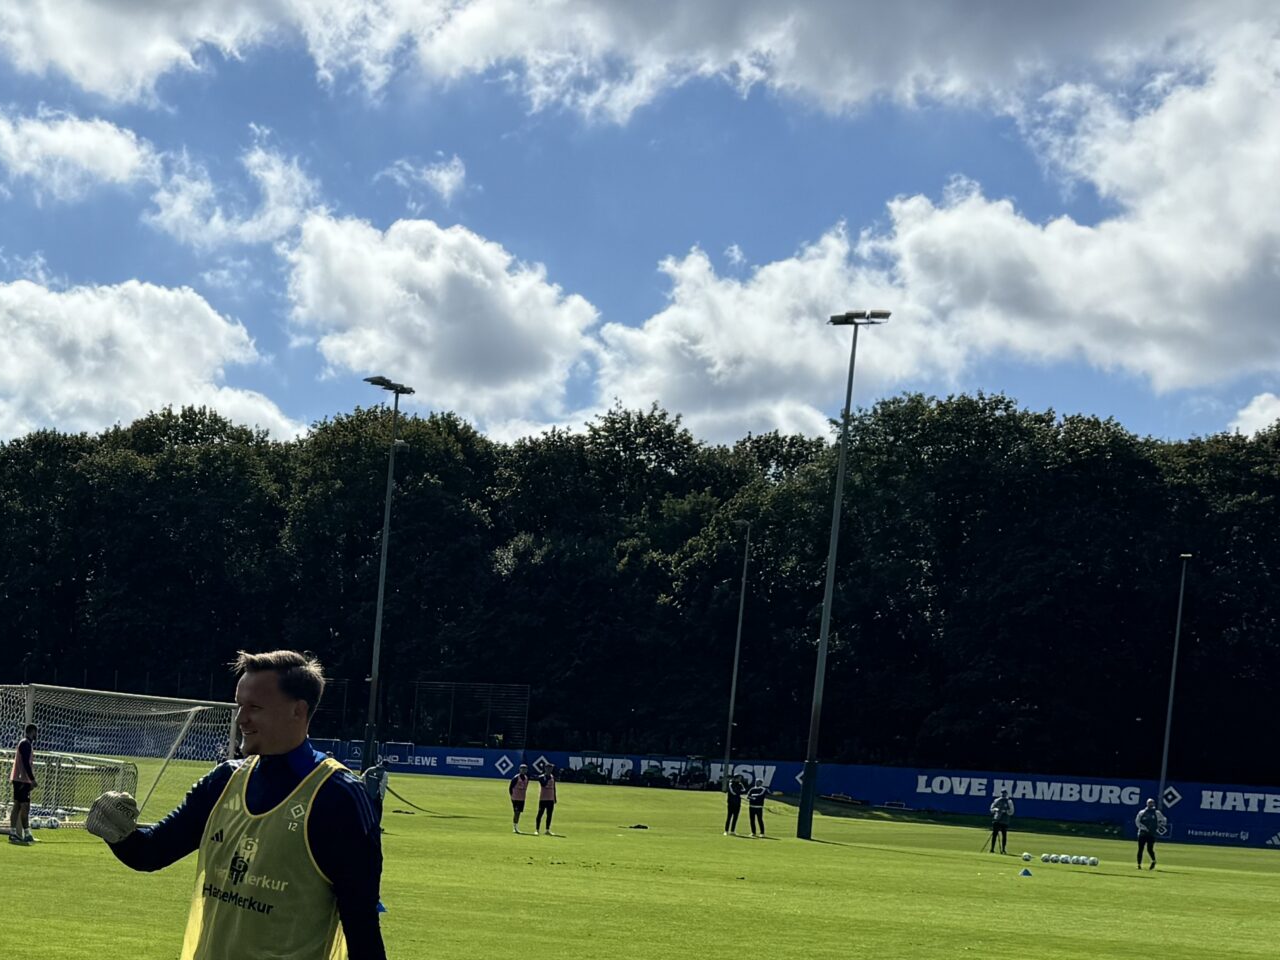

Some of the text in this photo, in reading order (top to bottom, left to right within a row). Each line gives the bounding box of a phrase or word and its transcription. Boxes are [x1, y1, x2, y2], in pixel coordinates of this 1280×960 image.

[407, 755, 438, 767] REWE
[710, 763, 777, 788] HSV
[916, 775, 1141, 805] LOVE HAMBURG
[287, 822, 298, 831] 12
[202, 883, 274, 914] HaeMerkur
